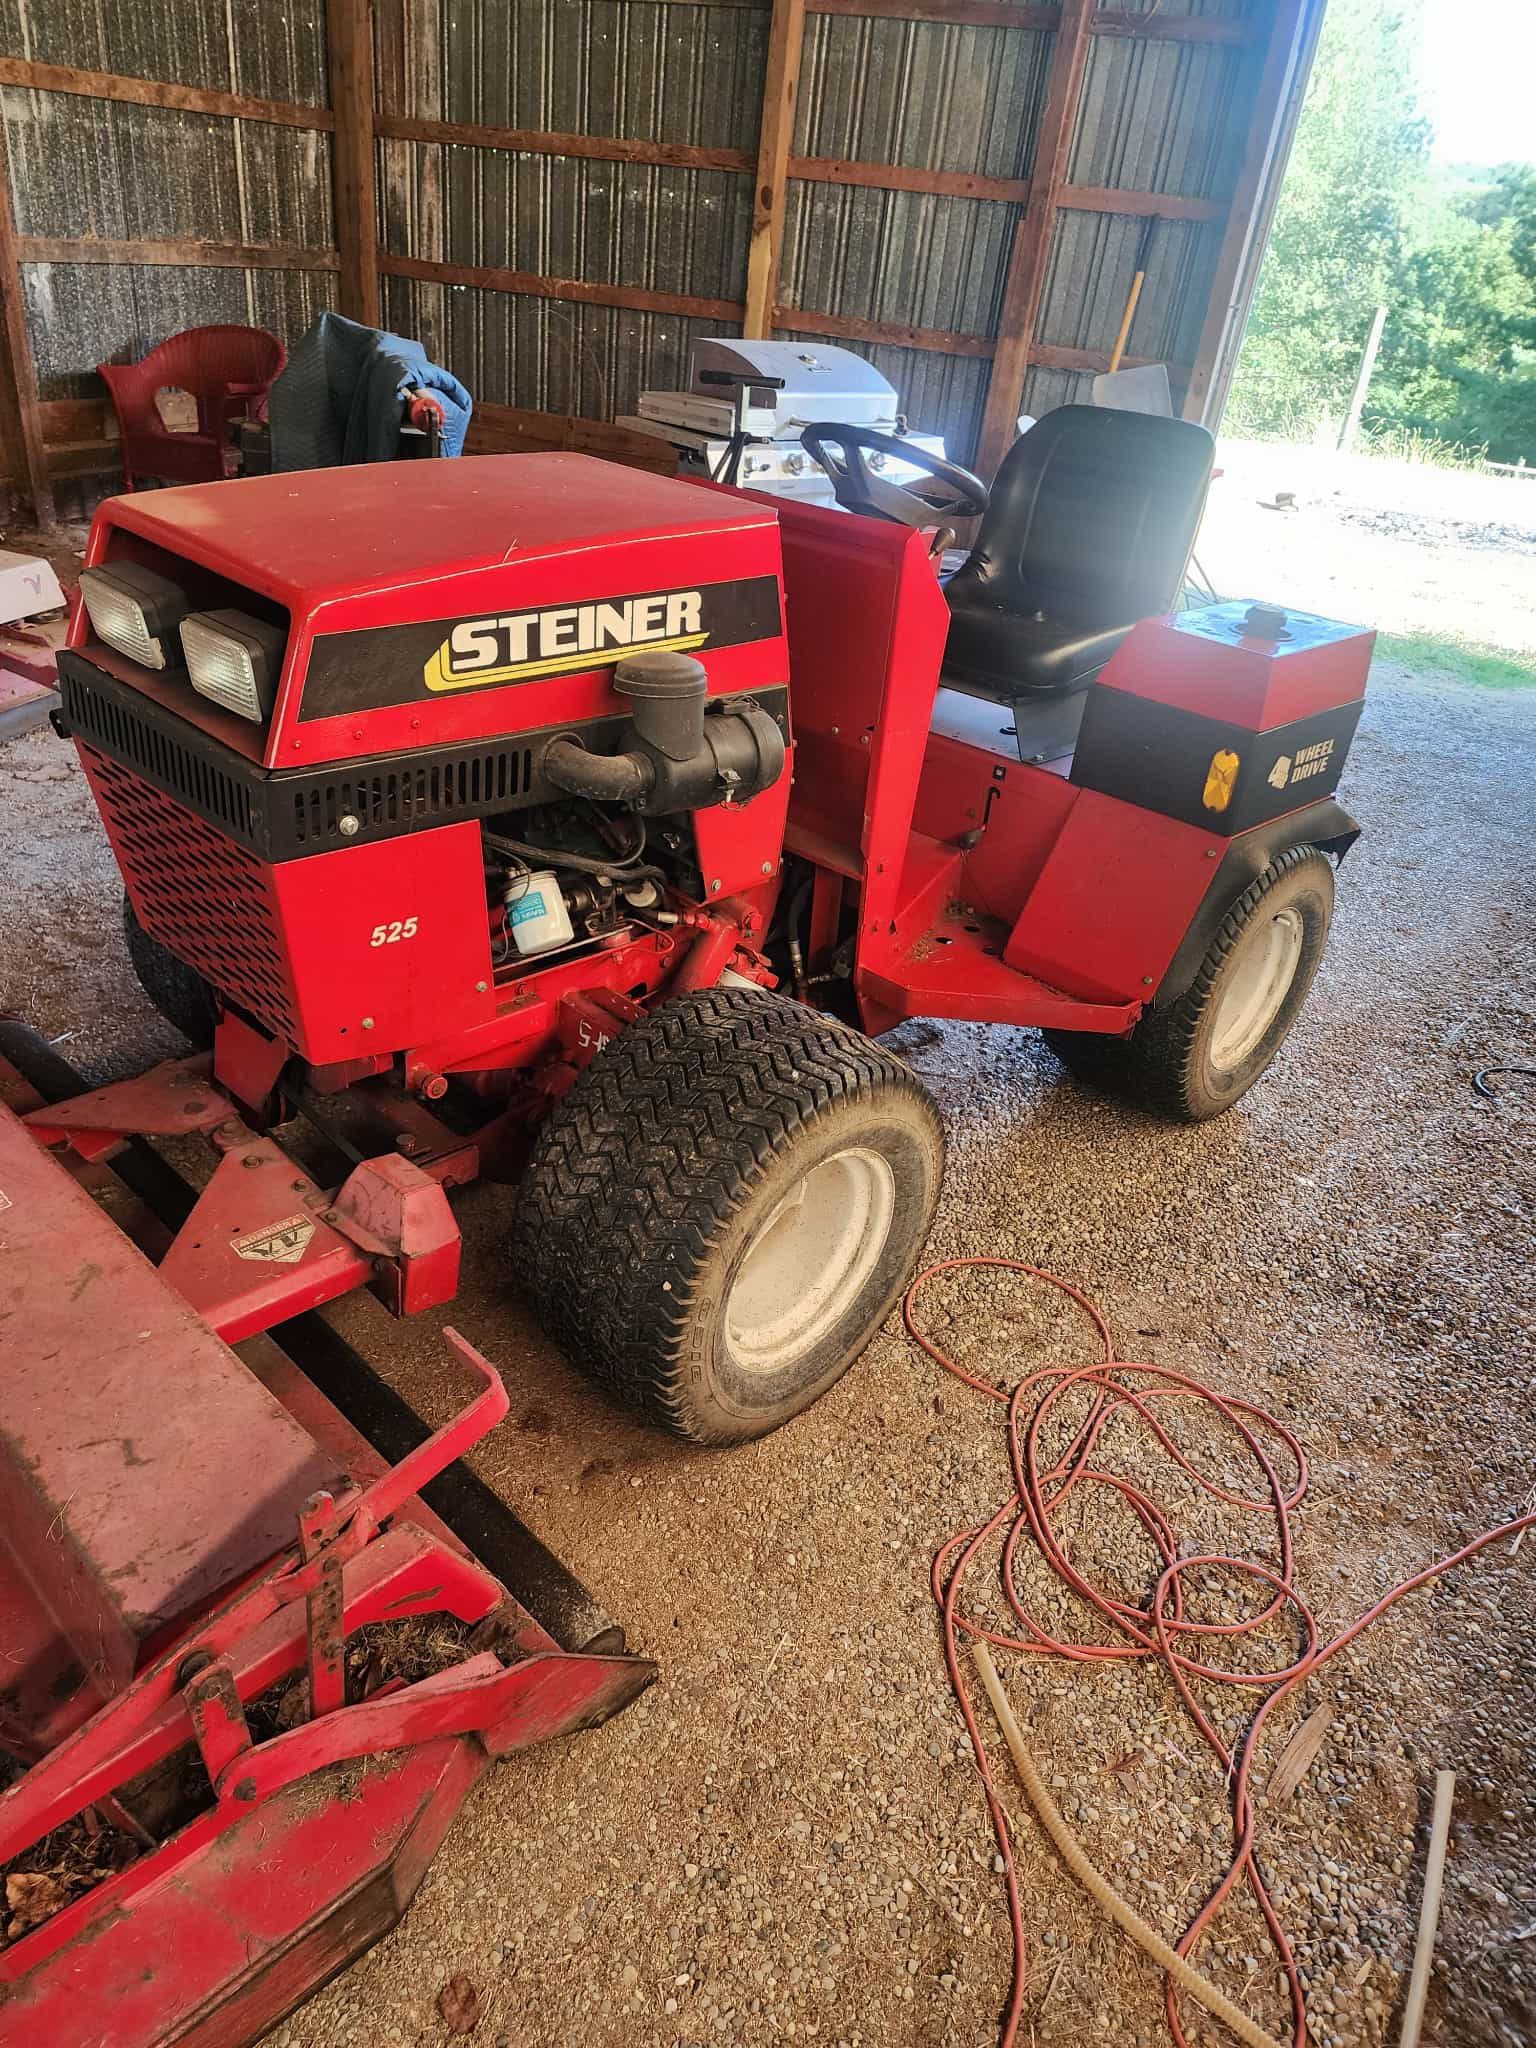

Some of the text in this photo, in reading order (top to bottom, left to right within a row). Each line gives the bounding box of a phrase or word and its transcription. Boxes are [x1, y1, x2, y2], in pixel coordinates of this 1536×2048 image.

[451, 591, 702, 671] STEINER
[1295, 739, 1334, 766] WHEEL
[1291, 757, 1328, 783] DRIVE
[369, 915, 419, 948] 525
